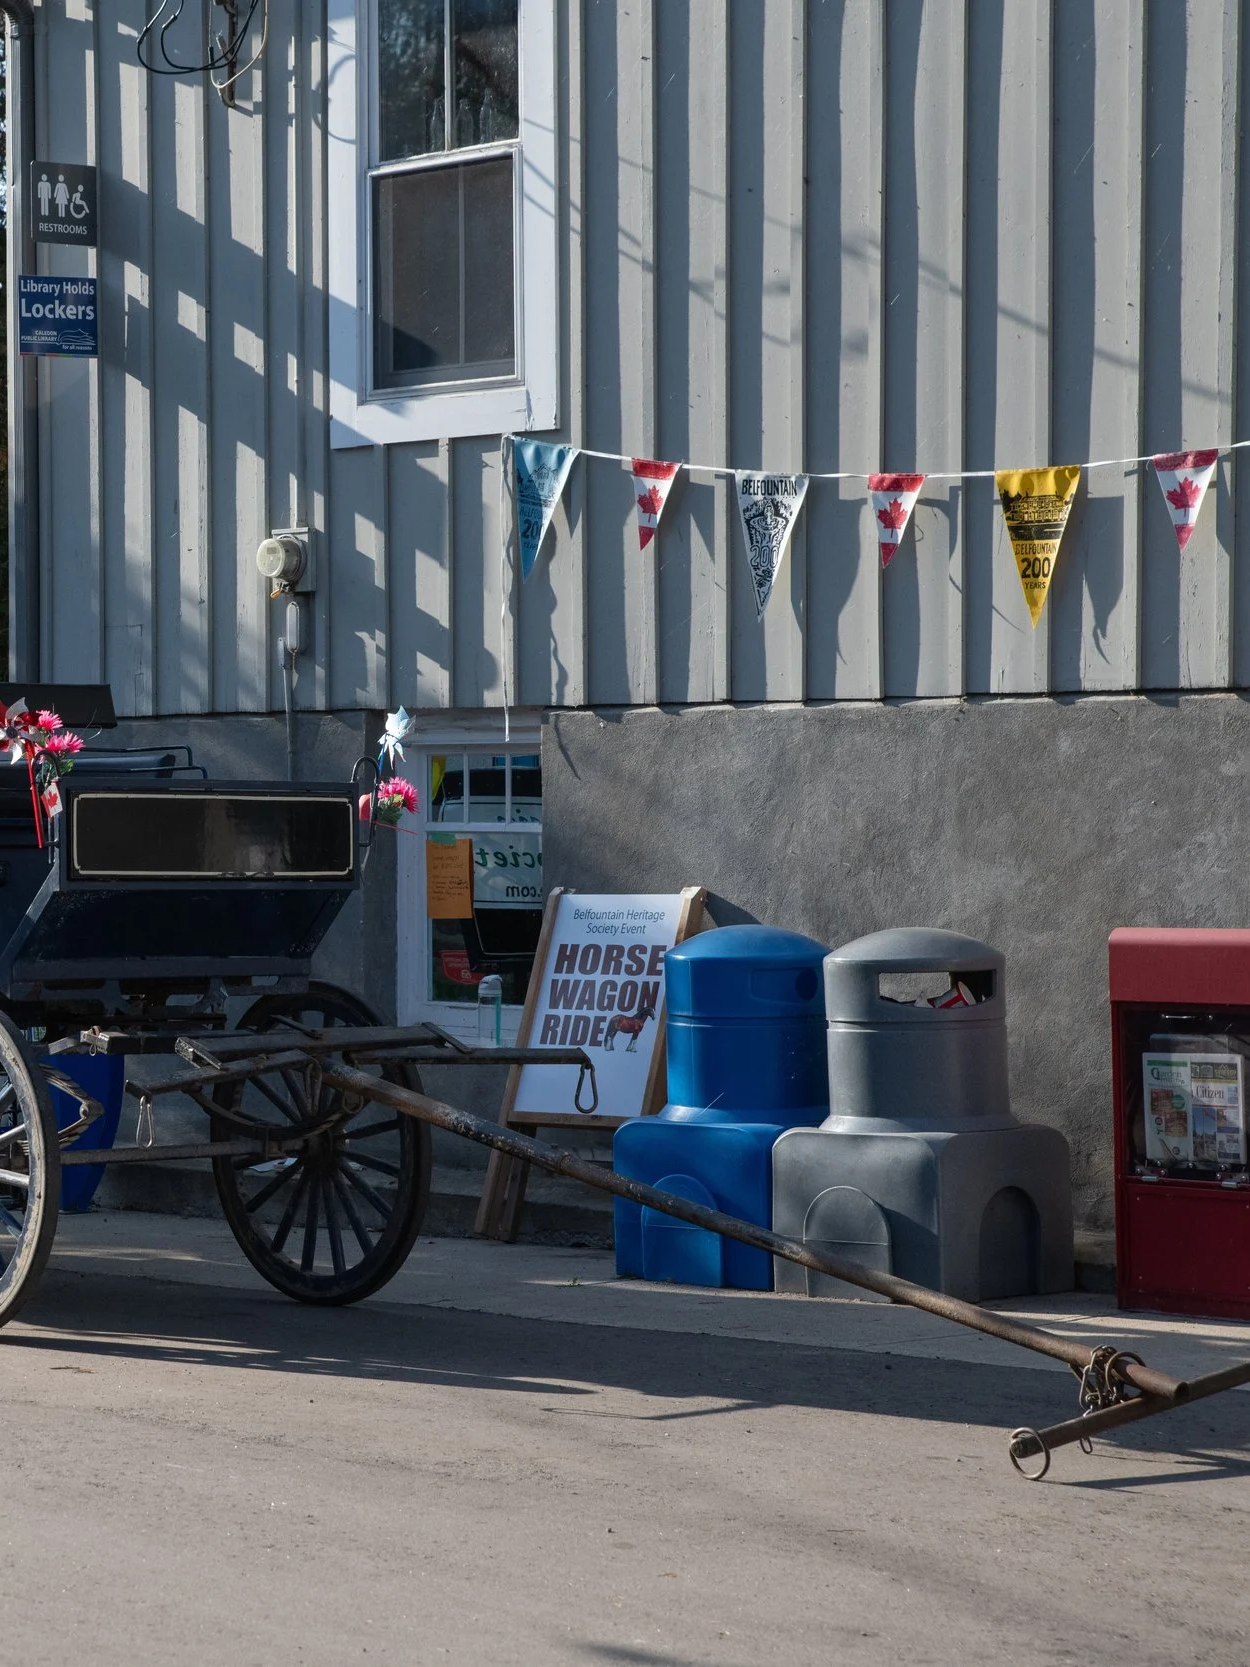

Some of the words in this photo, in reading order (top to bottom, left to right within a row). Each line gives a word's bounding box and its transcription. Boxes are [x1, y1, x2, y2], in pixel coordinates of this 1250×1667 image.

[39, 223, 87, 235] RESTROOMS
[20, 279, 60, 297] Library
[62, 281, 95, 296] Holds
[20, 298, 95, 320] Lockers
[742, 479, 797, 496] BELFOUNTAIN
[750, 545, 779, 568] 200
[1021, 557, 1050, 578] 200
[1025, 582, 1046, 590] YEARS
[573, 908, 624, 920] Belfountain
[626, 909, 665, 923] Heritage
[586, 922, 619, 936] Society
[620, 923, 646, 934] Event
[553, 943, 668, 977] HORSE
[548, 979, 661, 1013] WAGON
[539, 1013, 607, 1047] RIDE
[1196, 1085, 1225, 1099] Citizen
